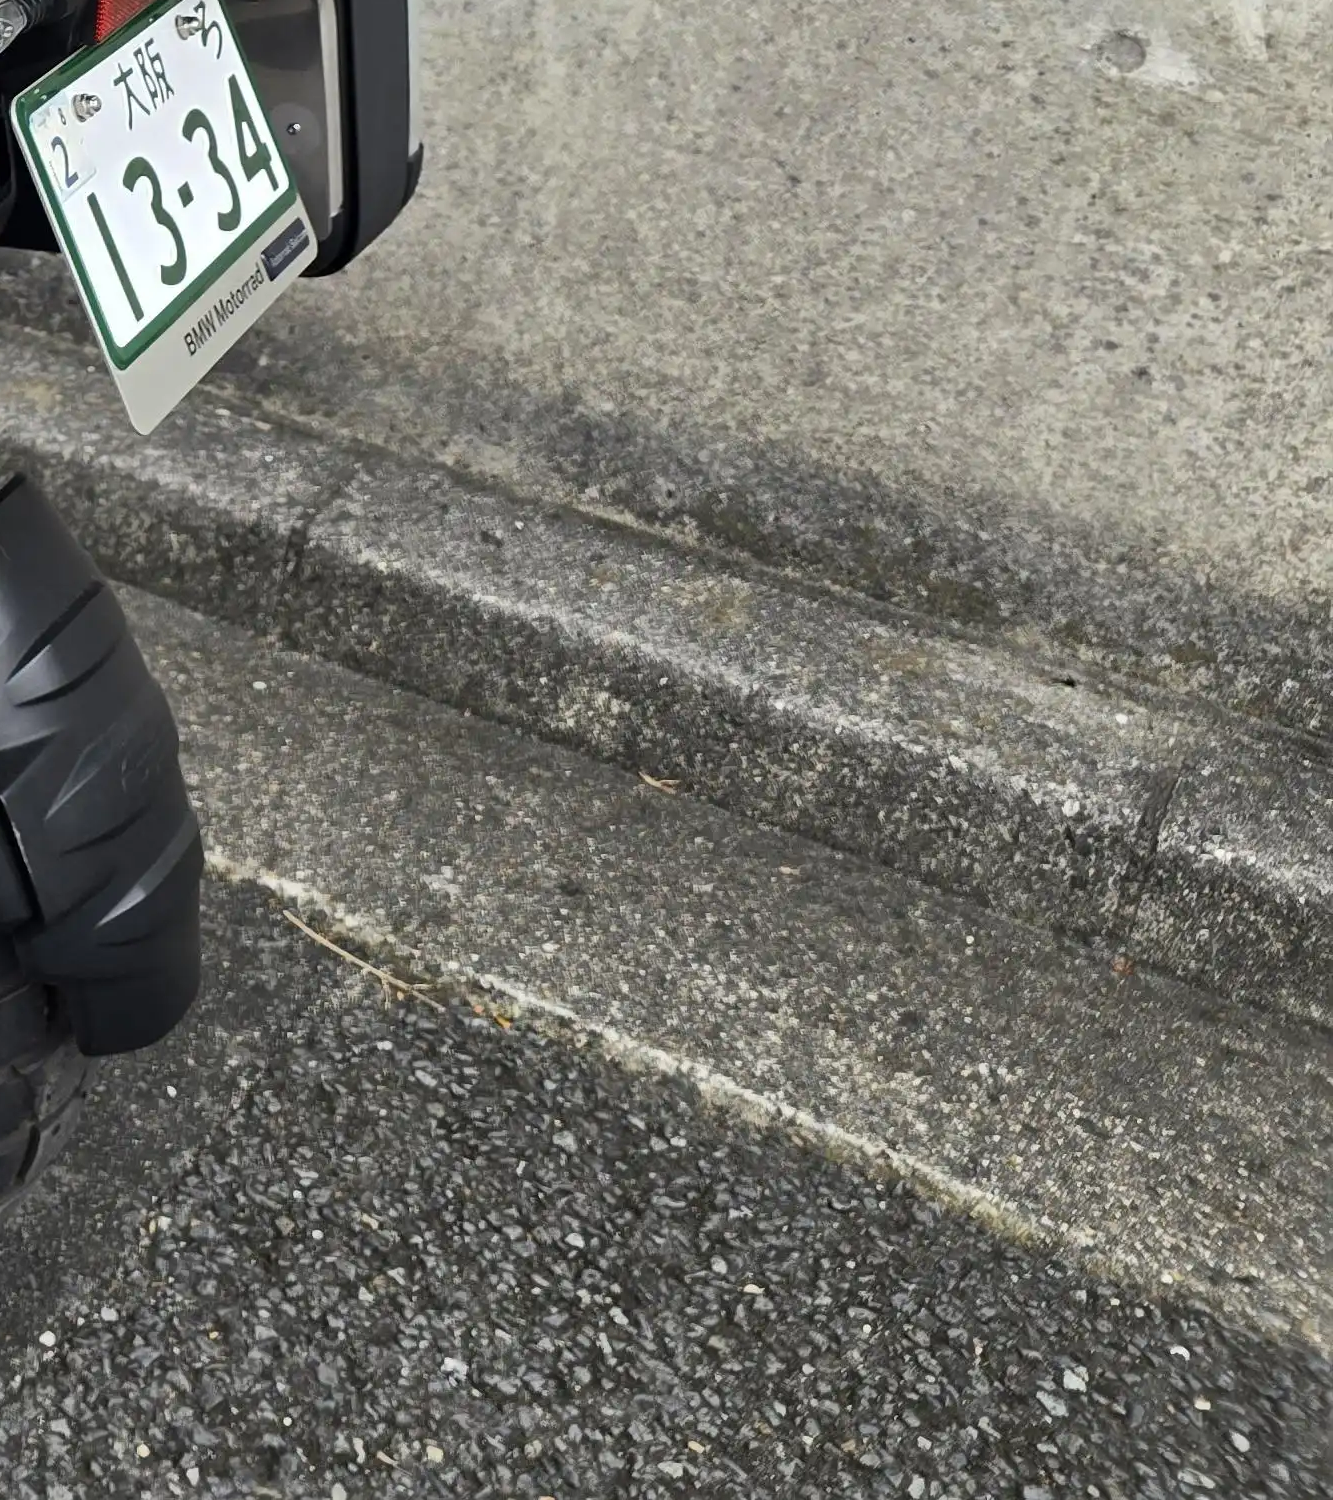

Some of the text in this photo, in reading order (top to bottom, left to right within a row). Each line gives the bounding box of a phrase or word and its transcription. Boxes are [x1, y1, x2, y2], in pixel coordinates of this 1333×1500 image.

[114, 38, 174, 130] 大阪
[50, 136, 79, 189] 2
[183, 262, 265, 357] BMW Motorrad
